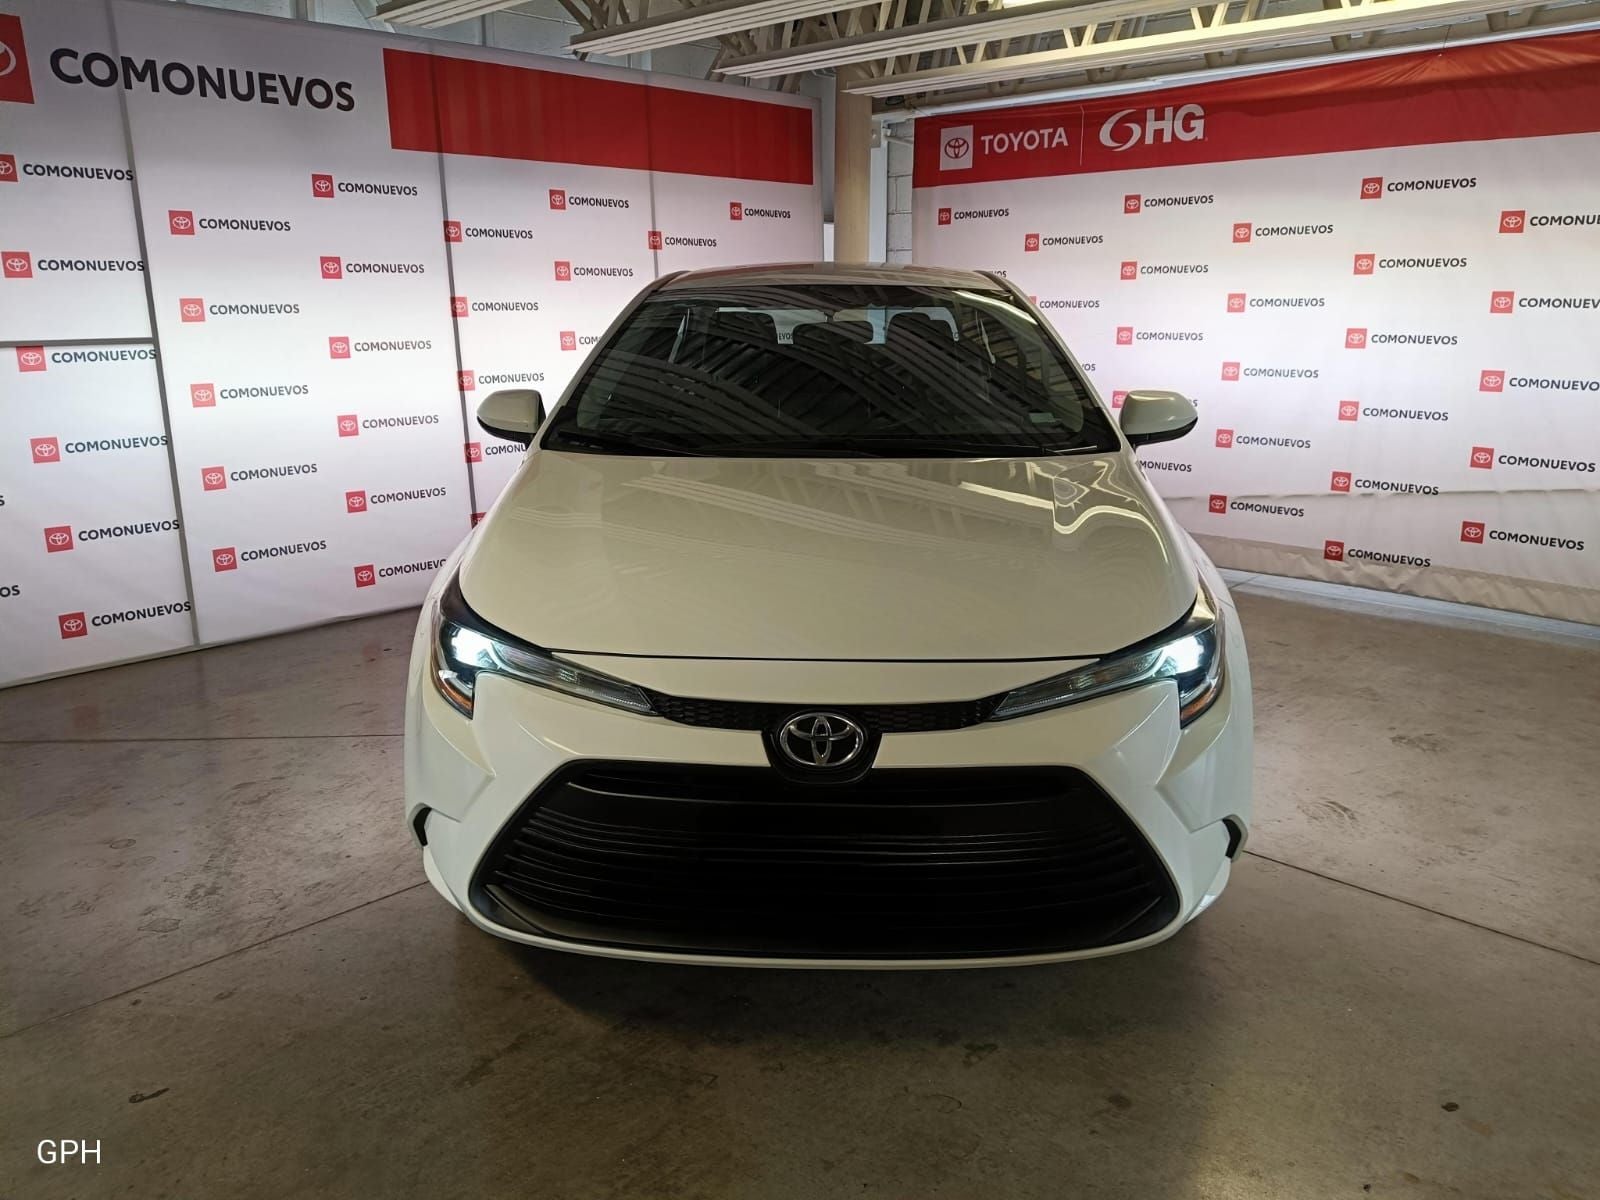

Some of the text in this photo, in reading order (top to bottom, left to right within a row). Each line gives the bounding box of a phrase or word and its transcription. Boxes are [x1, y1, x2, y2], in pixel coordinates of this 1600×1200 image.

[49, 47, 355, 112] COMONUEVOS
[981, 127, 1069, 155] TOYOTA
[22, 163, 134, 182] COMONUEVOS
[337, 182, 418, 196] COMONUEVOS
[1386, 177, 1477, 193] COMONUEVOS
[568, 196, 630, 209] COMONUEVOS
[1143, 195, 1214, 208] COMONUEVOS
[743, 208, 791, 219] COMONUEVOS
[953, 208, 1009, 220] COMONUEVOS
[198, 217, 291, 232] COMONUEVOS
[1529, 215, 1600, 226] COMONUE
[464, 227, 533, 239] COMONUEVOS
[1254, 224, 1334, 237] COMONUEVOS
[664, 237, 717, 247] COMONUEVOS
[1042, 236, 1103, 246] COMONUEVOS
[37, 259, 145, 272] COMONUEVOS
[345, 263, 425, 274] COMONUEVOS
[1140, 264, 1209, 275] COMONUEVOS
[1378, 257, 1468, 269] COMONUEVOS
[573, 267, 634, 277] COMONUEVOS
[471, 302, 539, 312] COMONUEVOS
[1039, 300, 1100, 309] COMONUEVOS
[1249, 298, 1325, 307] COMONUEVOS
[1518, 298, 1600, 308] COMONUEV
[208, 303, 300, 316] COMONUEVOS
[1135, 331, 1204, 342] COMONUEVOS
[1371, 334, 1458, 346] COMONUEVOS
[354, 340, 432, 352] COMONUEVOS
[51, 349, 157, 364] COMONUEVOS
[478, 373, 545, 384] COMONUEVOS
[1243, 367, 1319, 379] COMONUEVOS
[1508, 377, 1600, 392] COMONUEVO
[219, 384, 309, 400] COMONUEVOS
[1362, 407, 1449, 422] COMONUEVOS
[362, 414, 439, 429] COMONUEVOS
[64, 435, 169, 454] COMONUEVOS
[1236, 435, 1311, 449] COMONUEVOS
[485, 445, 526, 456] COMONU
[1139, 460, 1192, 473] MONUEVOS
[1498, 454, 1596, 473] COMONUEVOS
[230, 463, 318, 482] COMONUEVOS
[1354, 479, 1439, 496] COMONUEVOS
[370, 487, 447, 504] COMONUEVOS
[1230, 501, 1305, 517] COMONUEVOS
[78, 519, 180, 542] COMONUEVOS
[1489, 529, 1585, 551] COMONUEVOS
[240, 540, 327, 562] COMONUEVOS
[1348, 548, 1431, 568] COMONUEVOS
[378, 559, 446, 578] COMONUEV
[91, 601, 192, 627] COMONUEVOS
